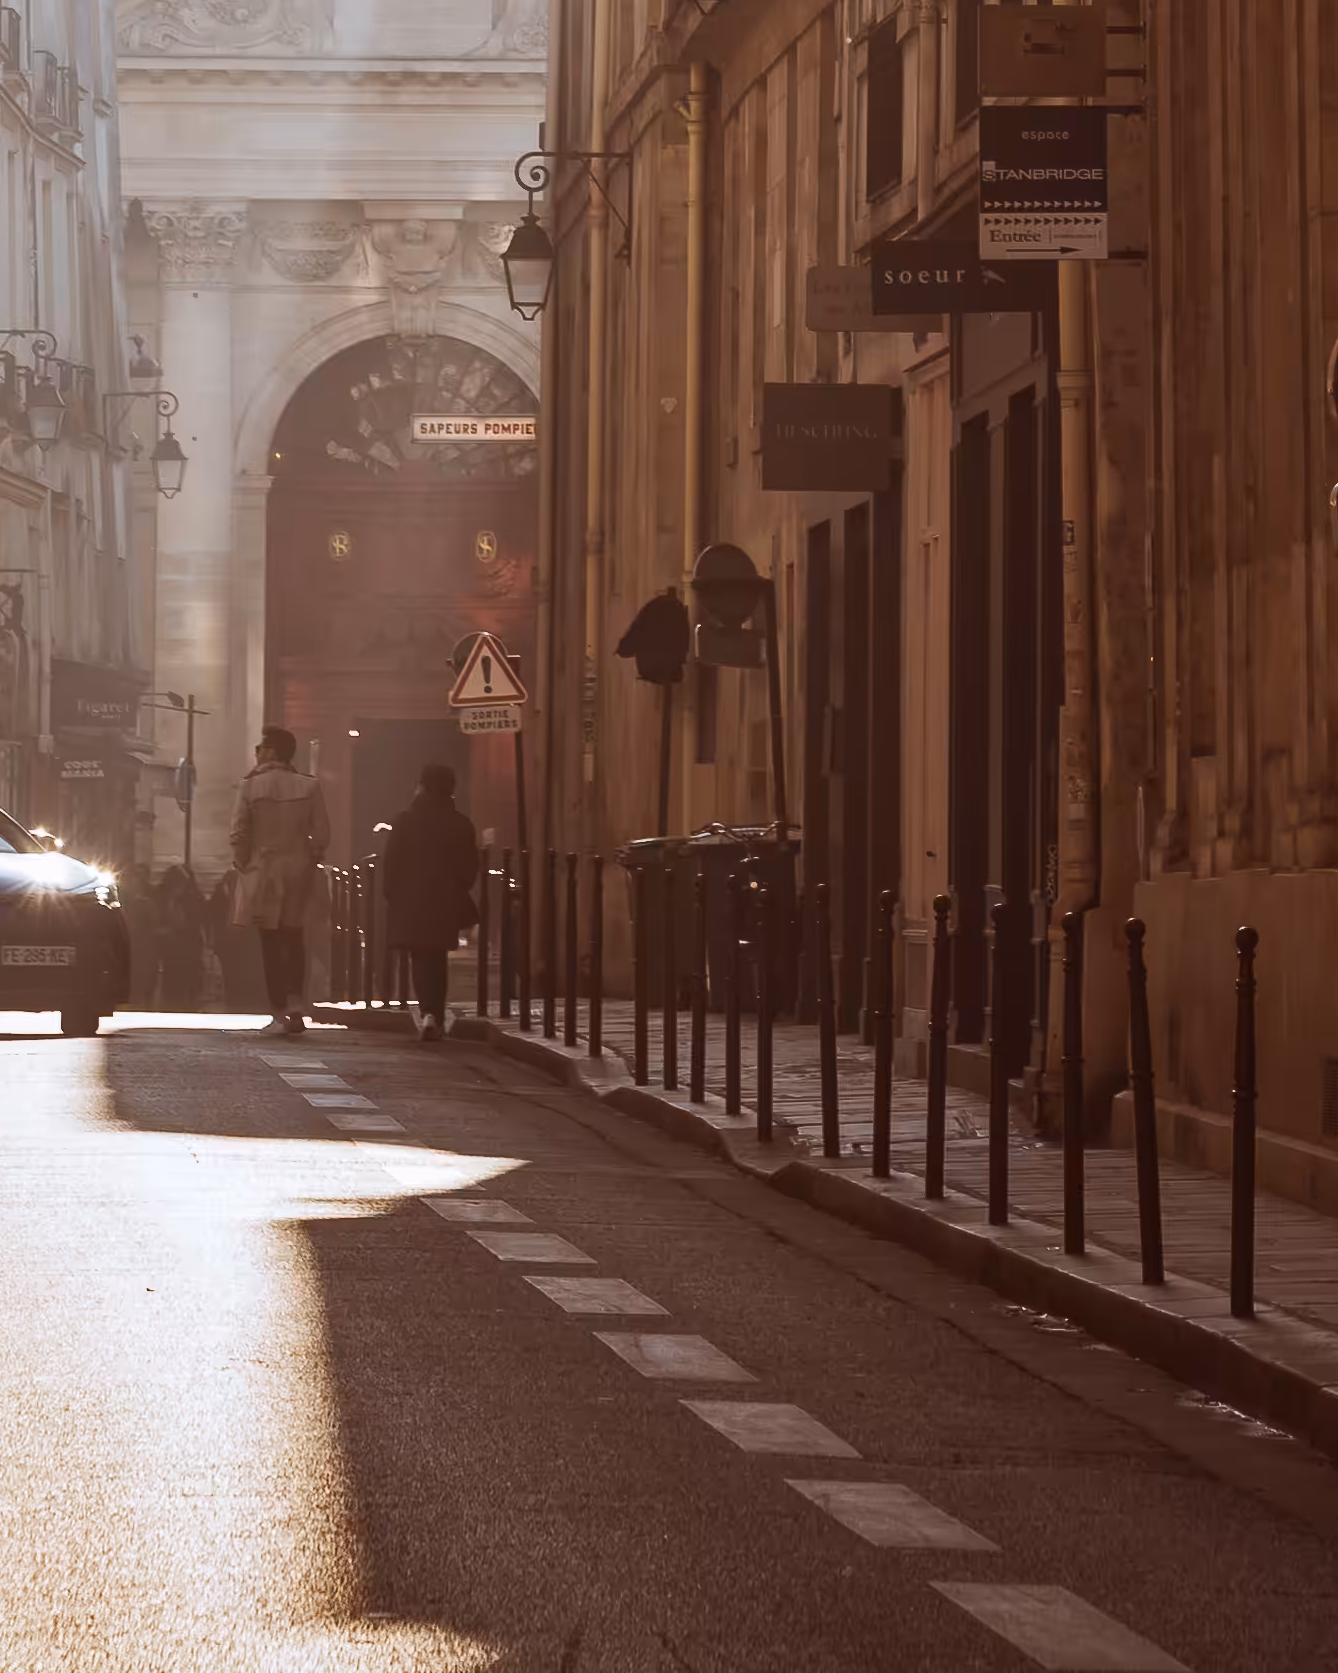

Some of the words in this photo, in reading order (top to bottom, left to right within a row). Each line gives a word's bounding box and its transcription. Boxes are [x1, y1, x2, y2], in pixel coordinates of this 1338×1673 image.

[1021, 130, 1070, 141] espace
[982, 168, 1104, 182] STANBRIDGE
[884, 268, 966, 285] soeur
[420, 422, 478, 435] SAPEURS
[484, 423, 536, 435] POMPIE
[471, 709, 509, 720] SORTIE
[463, 719, 518, 730] POMPIERS
